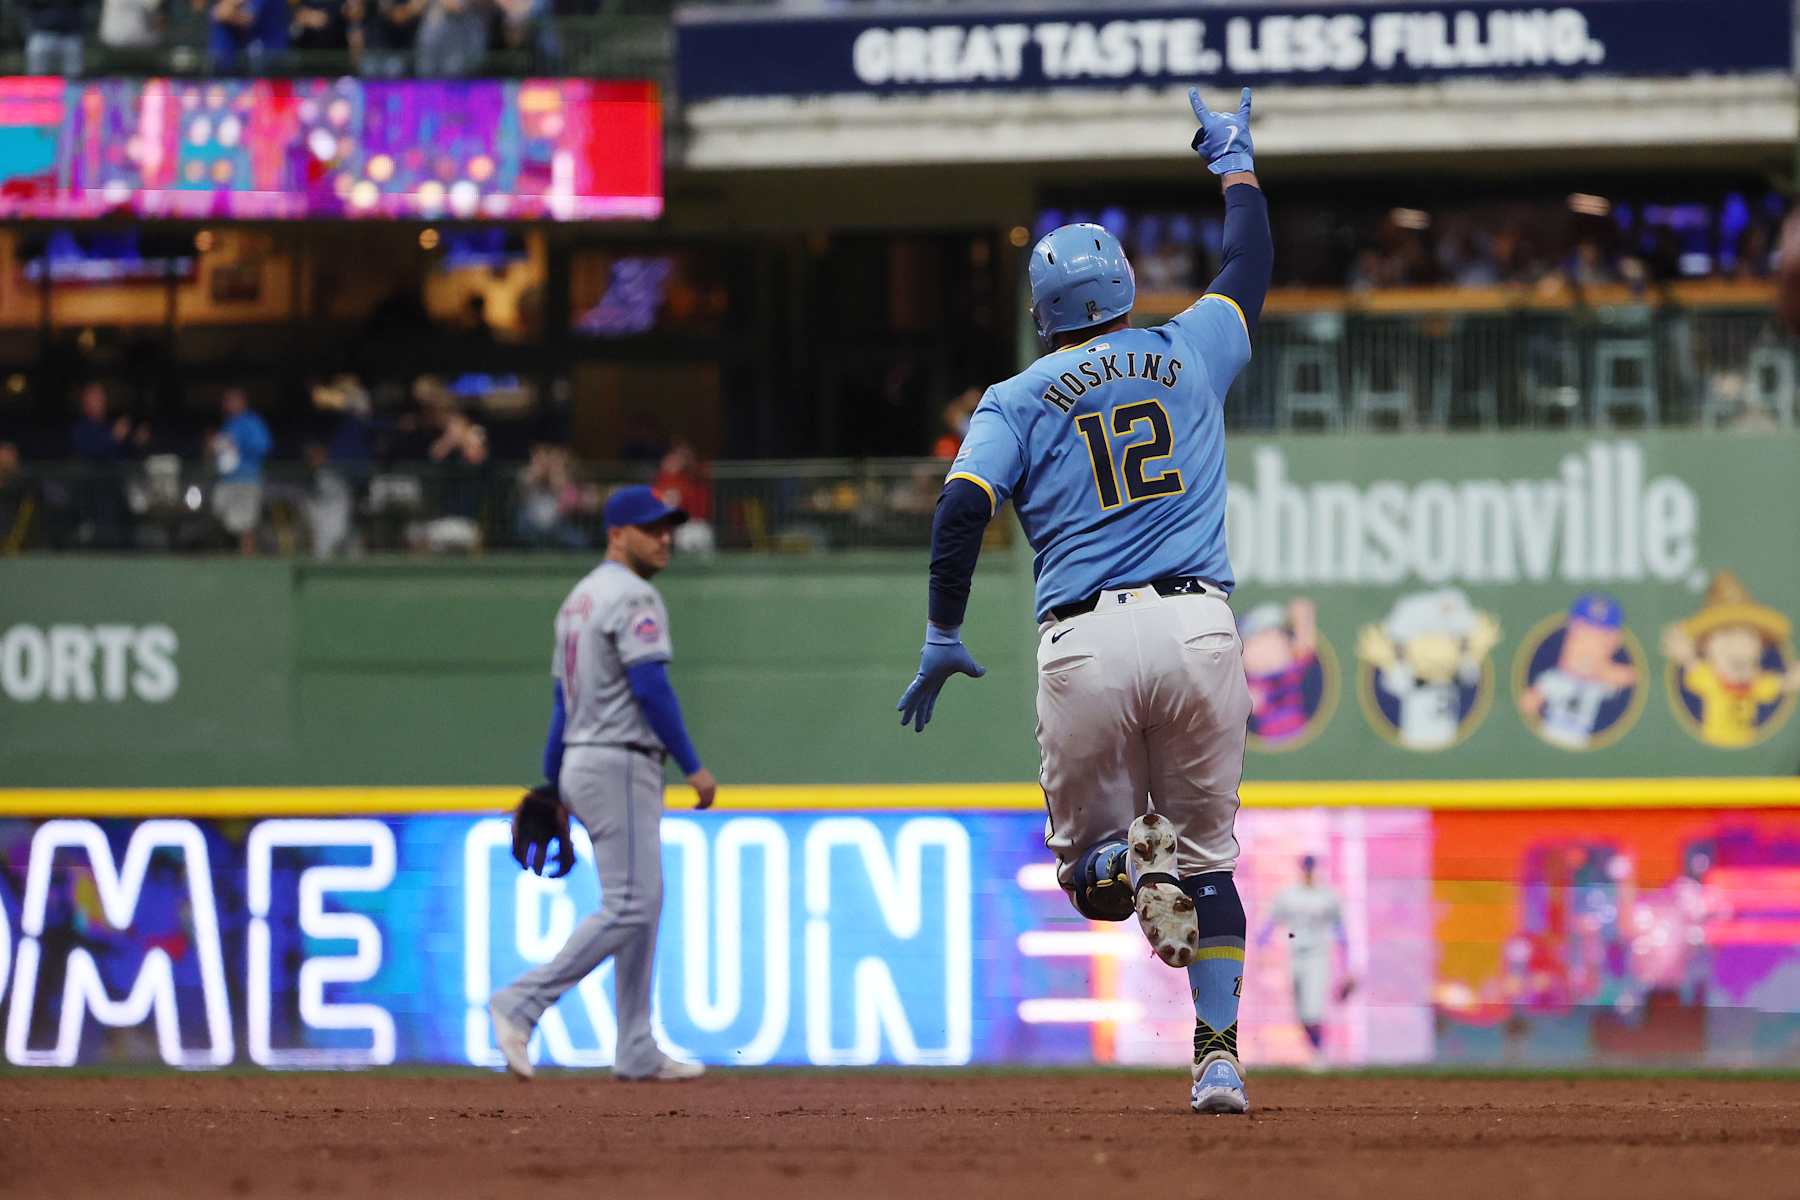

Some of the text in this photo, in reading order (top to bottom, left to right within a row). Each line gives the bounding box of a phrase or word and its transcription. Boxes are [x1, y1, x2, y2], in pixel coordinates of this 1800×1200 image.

[853, 8, 1605, 84] GREAT TASTE. LESS FILLING.
[1043, 351, 1183, 415] HOSKINS
[1074, 398, 1186, 511] 12
[1227, 440, 1700, 586] ohnsonville
[0, 622, 180, 702] ORTS
[0, 818, 398, 1068] ME
